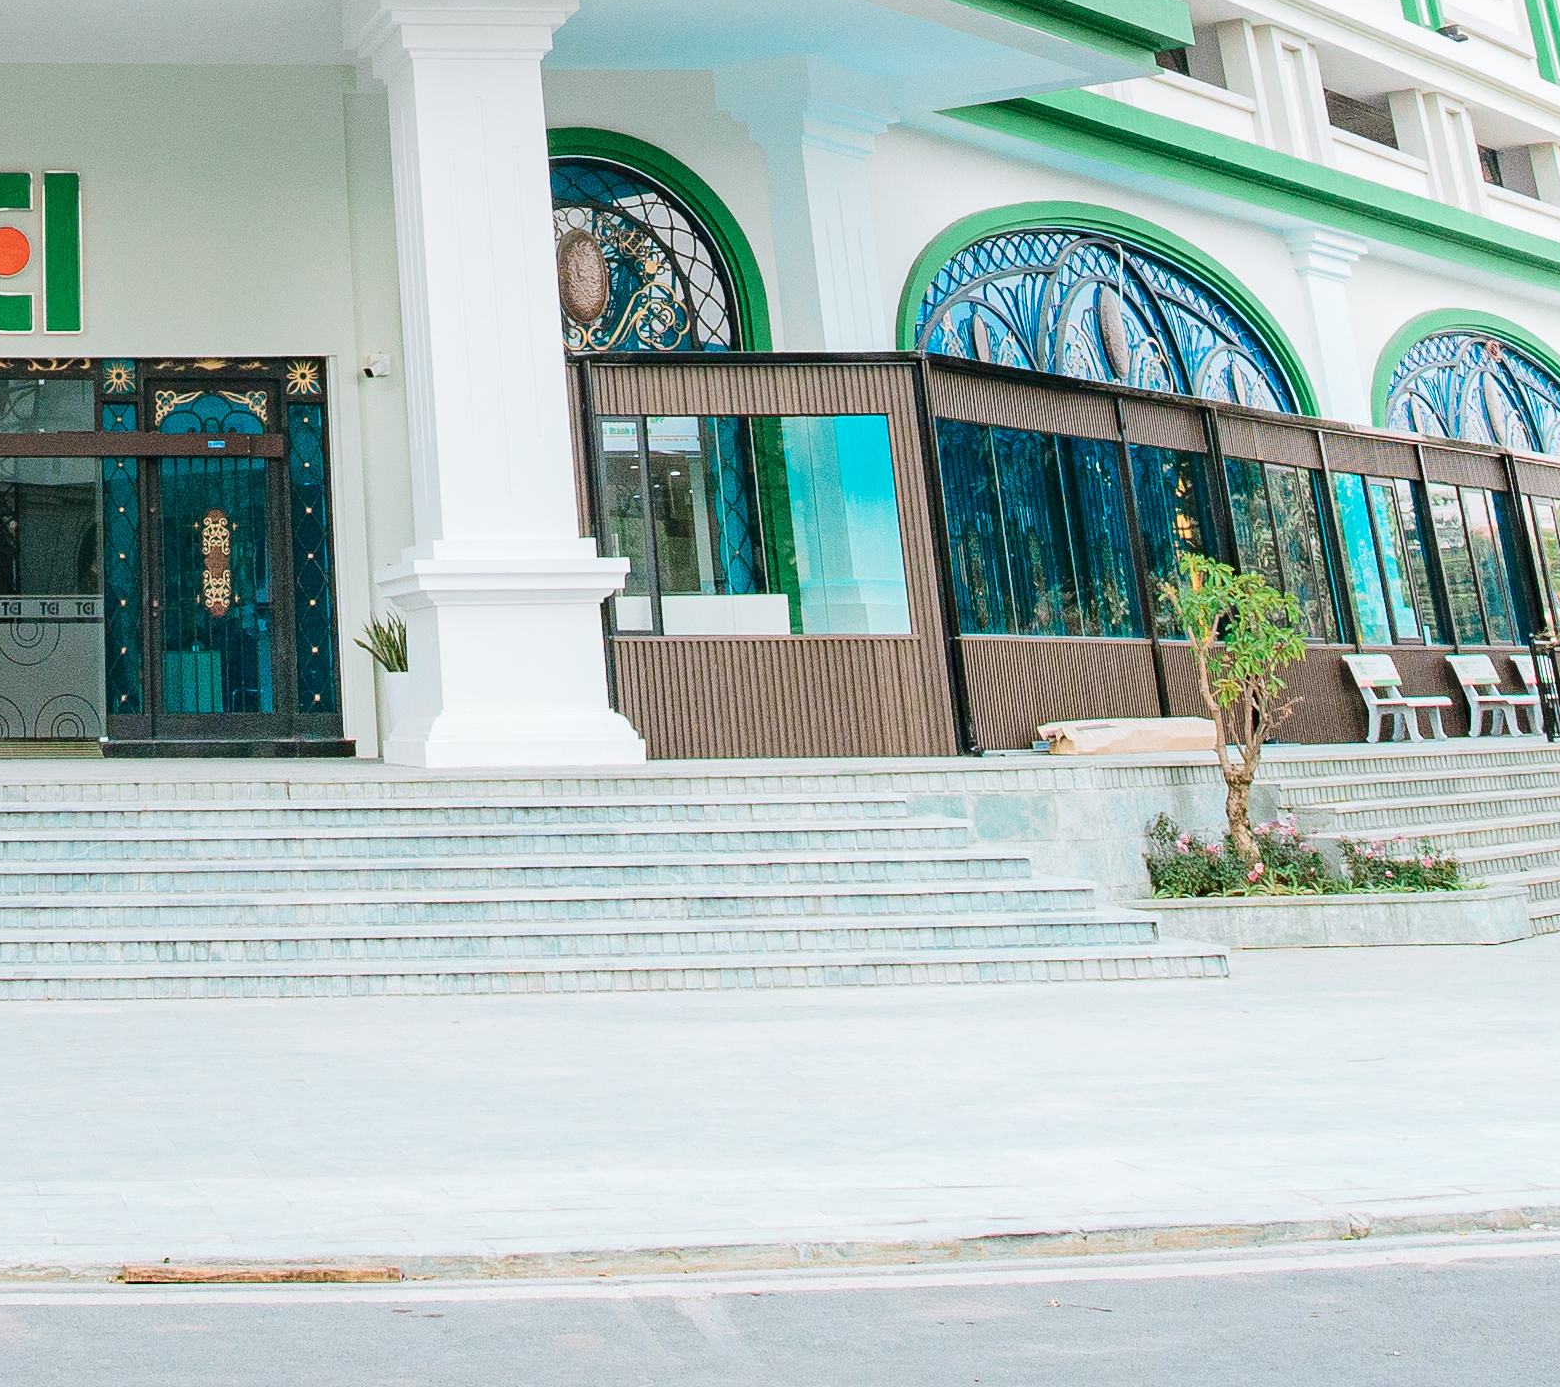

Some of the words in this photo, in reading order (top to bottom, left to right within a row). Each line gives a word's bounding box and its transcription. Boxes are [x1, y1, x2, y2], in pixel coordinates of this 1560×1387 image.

[2, 601, 22, 616] TCI
[39, 601, 60, 616] TCI
[75, 601, 95, 616] TCI
